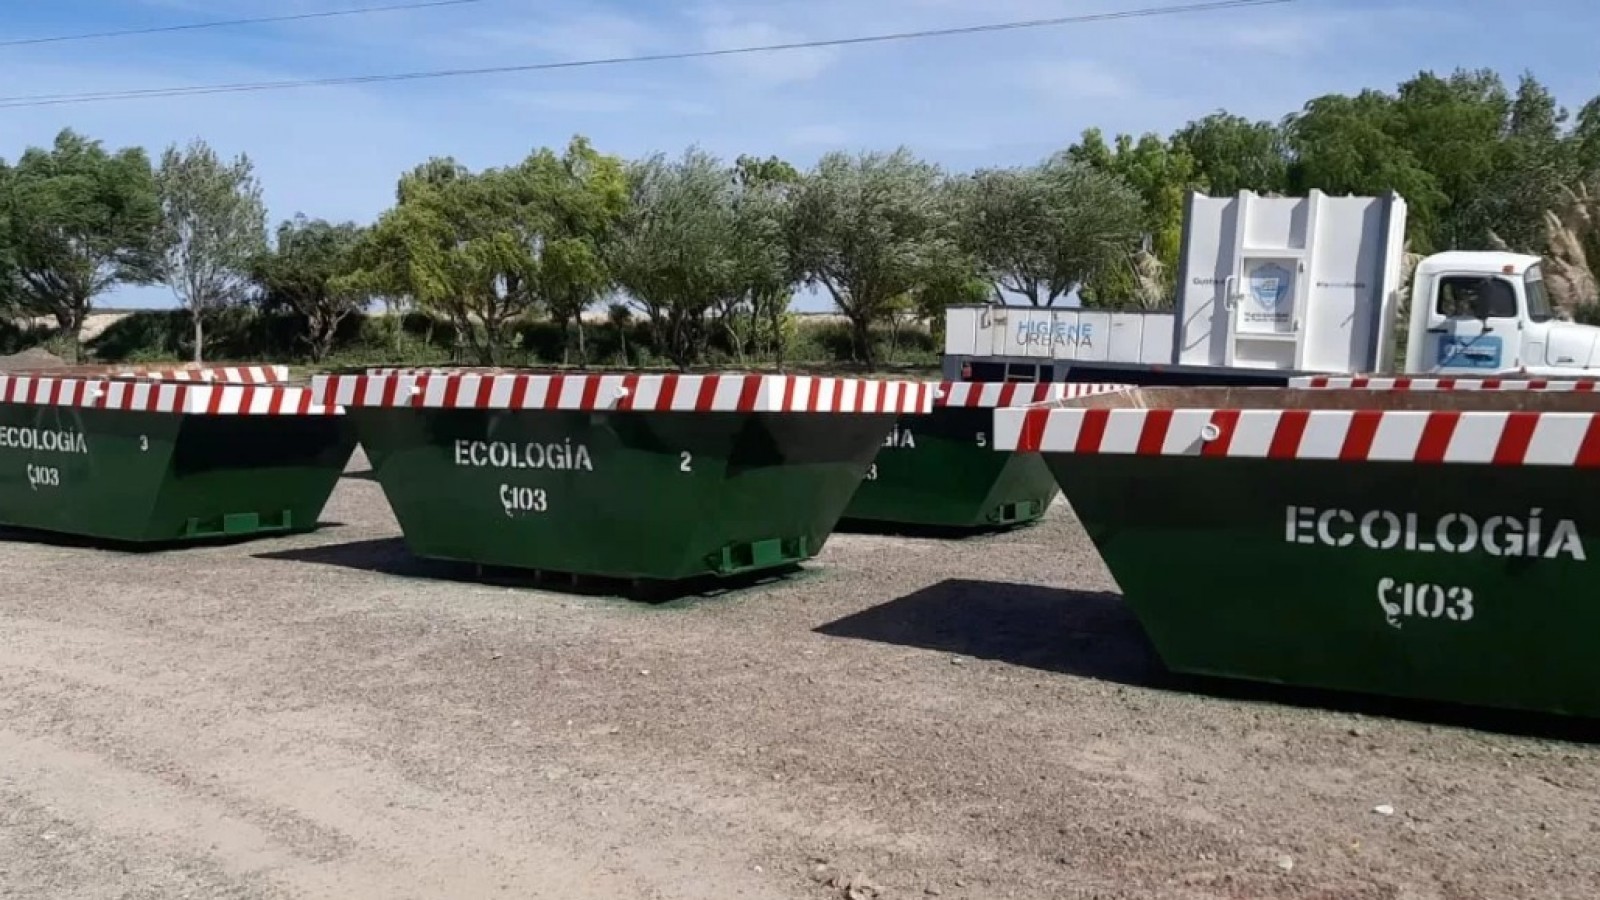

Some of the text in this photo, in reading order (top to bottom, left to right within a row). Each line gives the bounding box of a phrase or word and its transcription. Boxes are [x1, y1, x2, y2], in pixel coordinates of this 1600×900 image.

[1018, 320, 1093, 336] HIGIENE
[1017, 332, 1092, 348] URBANA
[0, 425, 88, 454] ECOLOGÍA
[139, 434, 149, 451] 3
[975, 431, 987, 447] 5
[454, 437, 593, 471] ECOLOGÍA
[680, 451, 692, 472] 2
[34, 466, 60, 486] 103
[512, 486, 547, 512] 103
[1285, 505, 1587, 561] ECOLOGÍA
[1403, 582, 1474, 621] 103
